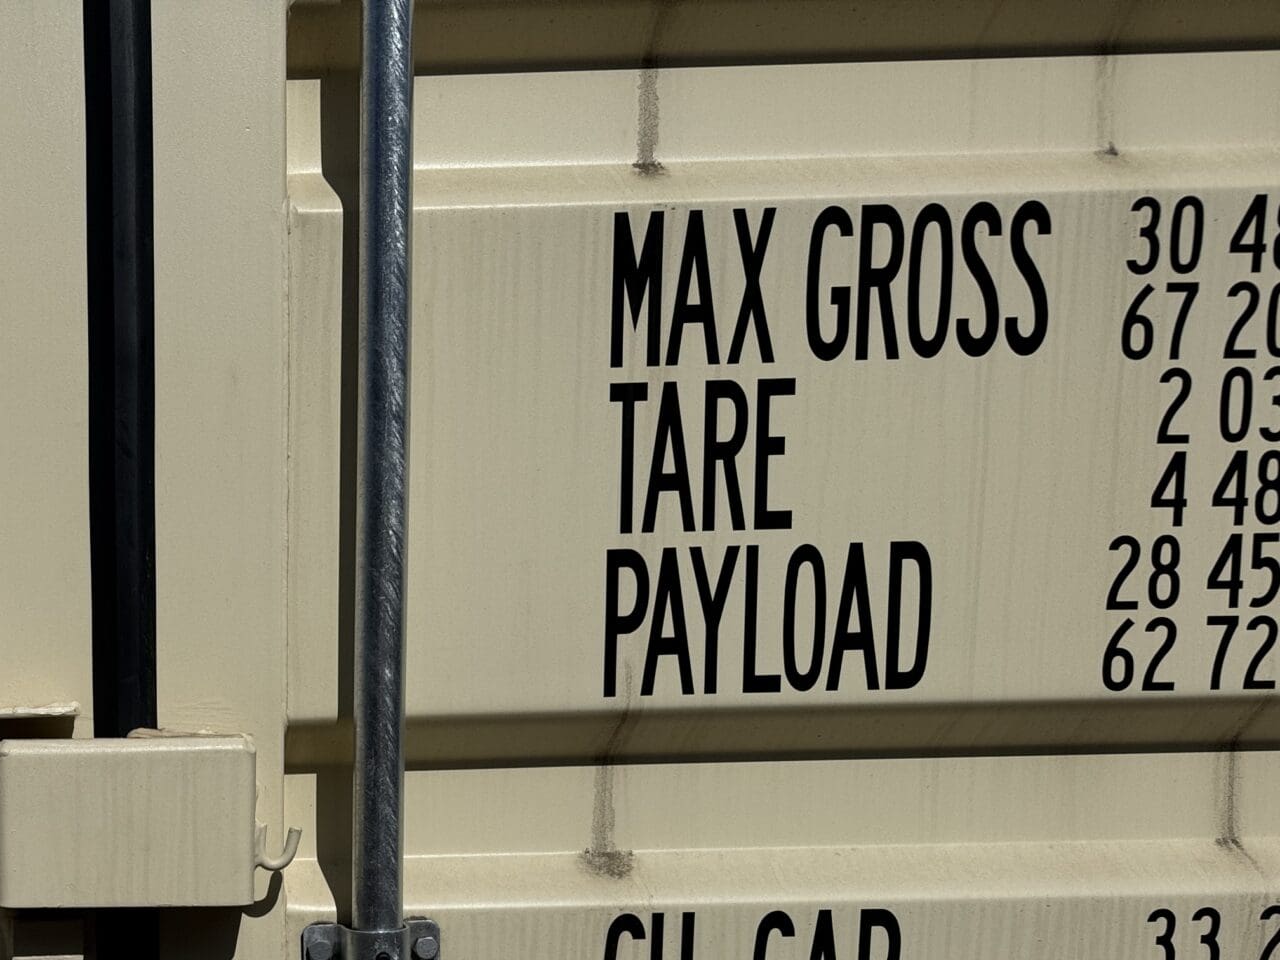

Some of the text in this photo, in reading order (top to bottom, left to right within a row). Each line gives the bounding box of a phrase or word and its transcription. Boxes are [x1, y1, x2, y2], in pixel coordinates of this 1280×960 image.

[1127, 194, 1280, 274] 30 4
[611, 201, 1051, 367] MAX GROSS
[1122, 283, 1199, 360] 67
[1157, 366, 1280, 443] 2 03
[610, 378, 795, 533] TARE
[1151, 450, 1280, 526] 4 48
[1107, 533, 1280, 610] 28 45
[604, 541, 932, 697] PAYLOAD
[1103, 616, 1278, 691] 62 72
